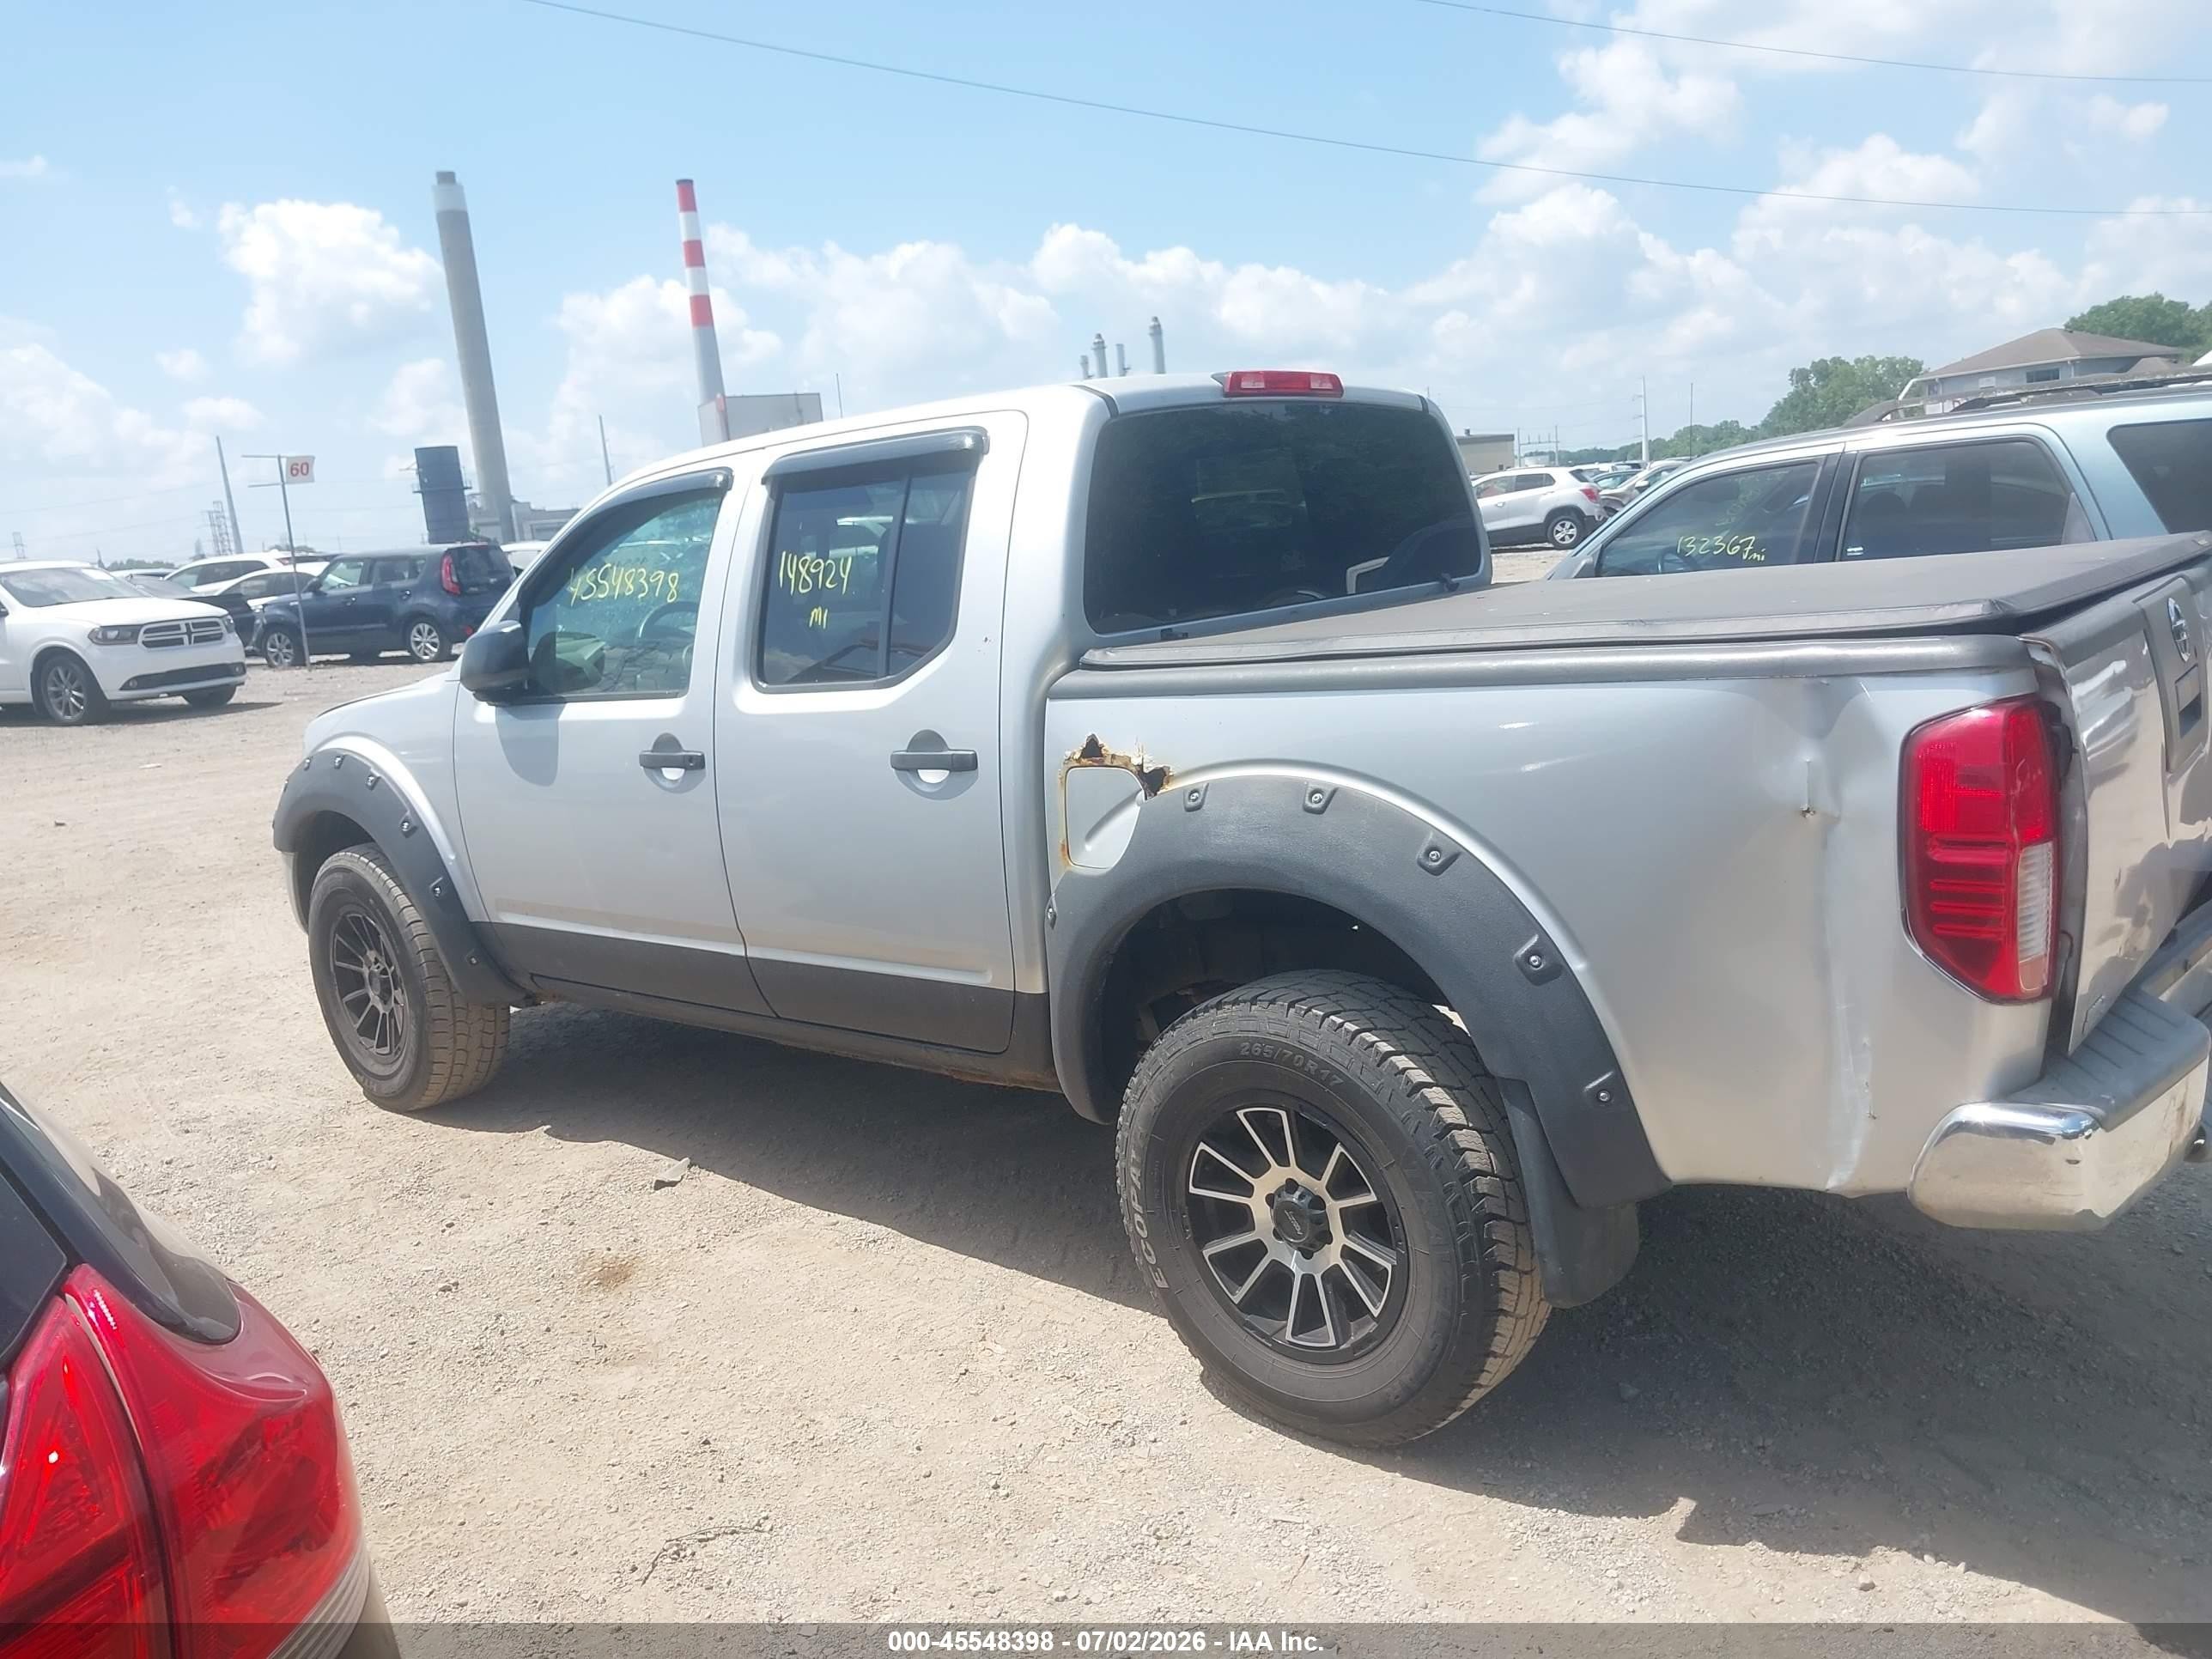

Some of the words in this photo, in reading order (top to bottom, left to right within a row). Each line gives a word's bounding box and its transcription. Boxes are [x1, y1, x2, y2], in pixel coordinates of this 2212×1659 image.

[289, 462, 310, 477] 60
[1676, 535, 1755, 560] 132367
[568, 563, 679, 606] 45548398
[779, 550, 852, 595] 148924
[1240, 1042, 1345, 1087] 265/70R17
